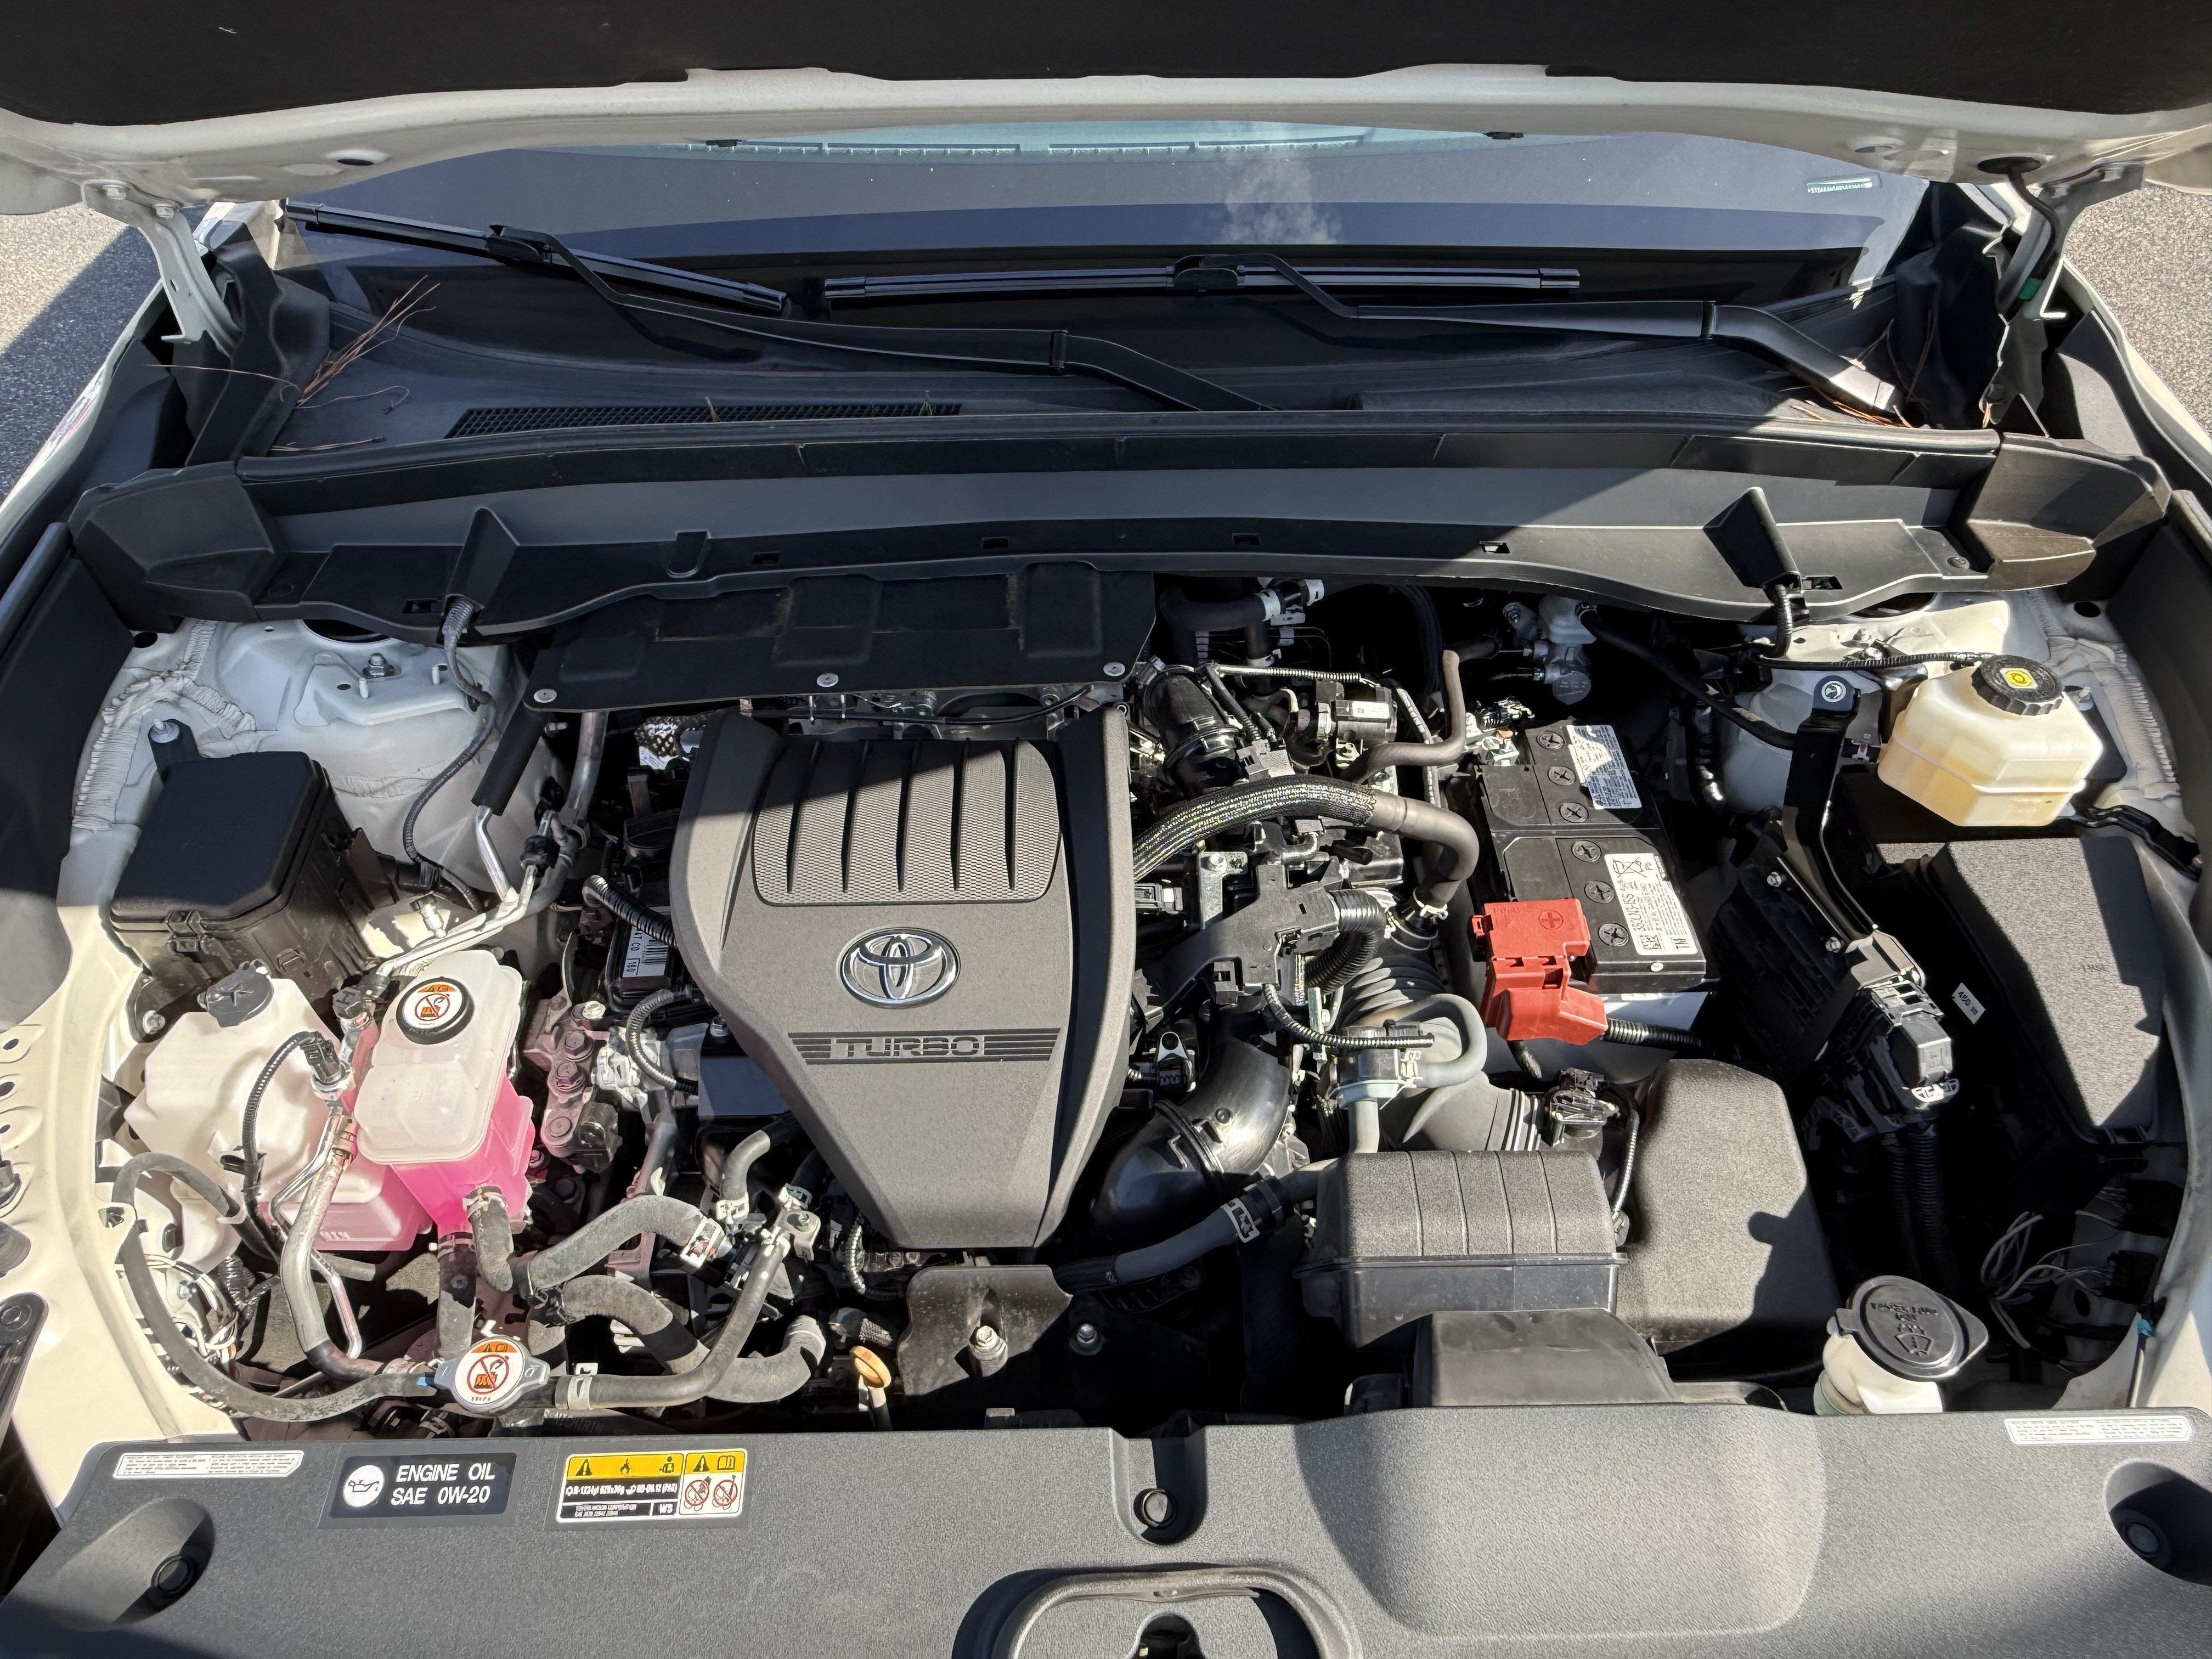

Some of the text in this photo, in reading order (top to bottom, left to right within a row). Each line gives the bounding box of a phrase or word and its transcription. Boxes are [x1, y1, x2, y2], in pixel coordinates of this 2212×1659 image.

[834, 1036, 980, 1057] TURBO
[396, 1462, 495, 1482] ENGINE OIL
[390, 1485, 491, 1506] SAE 0W-20
